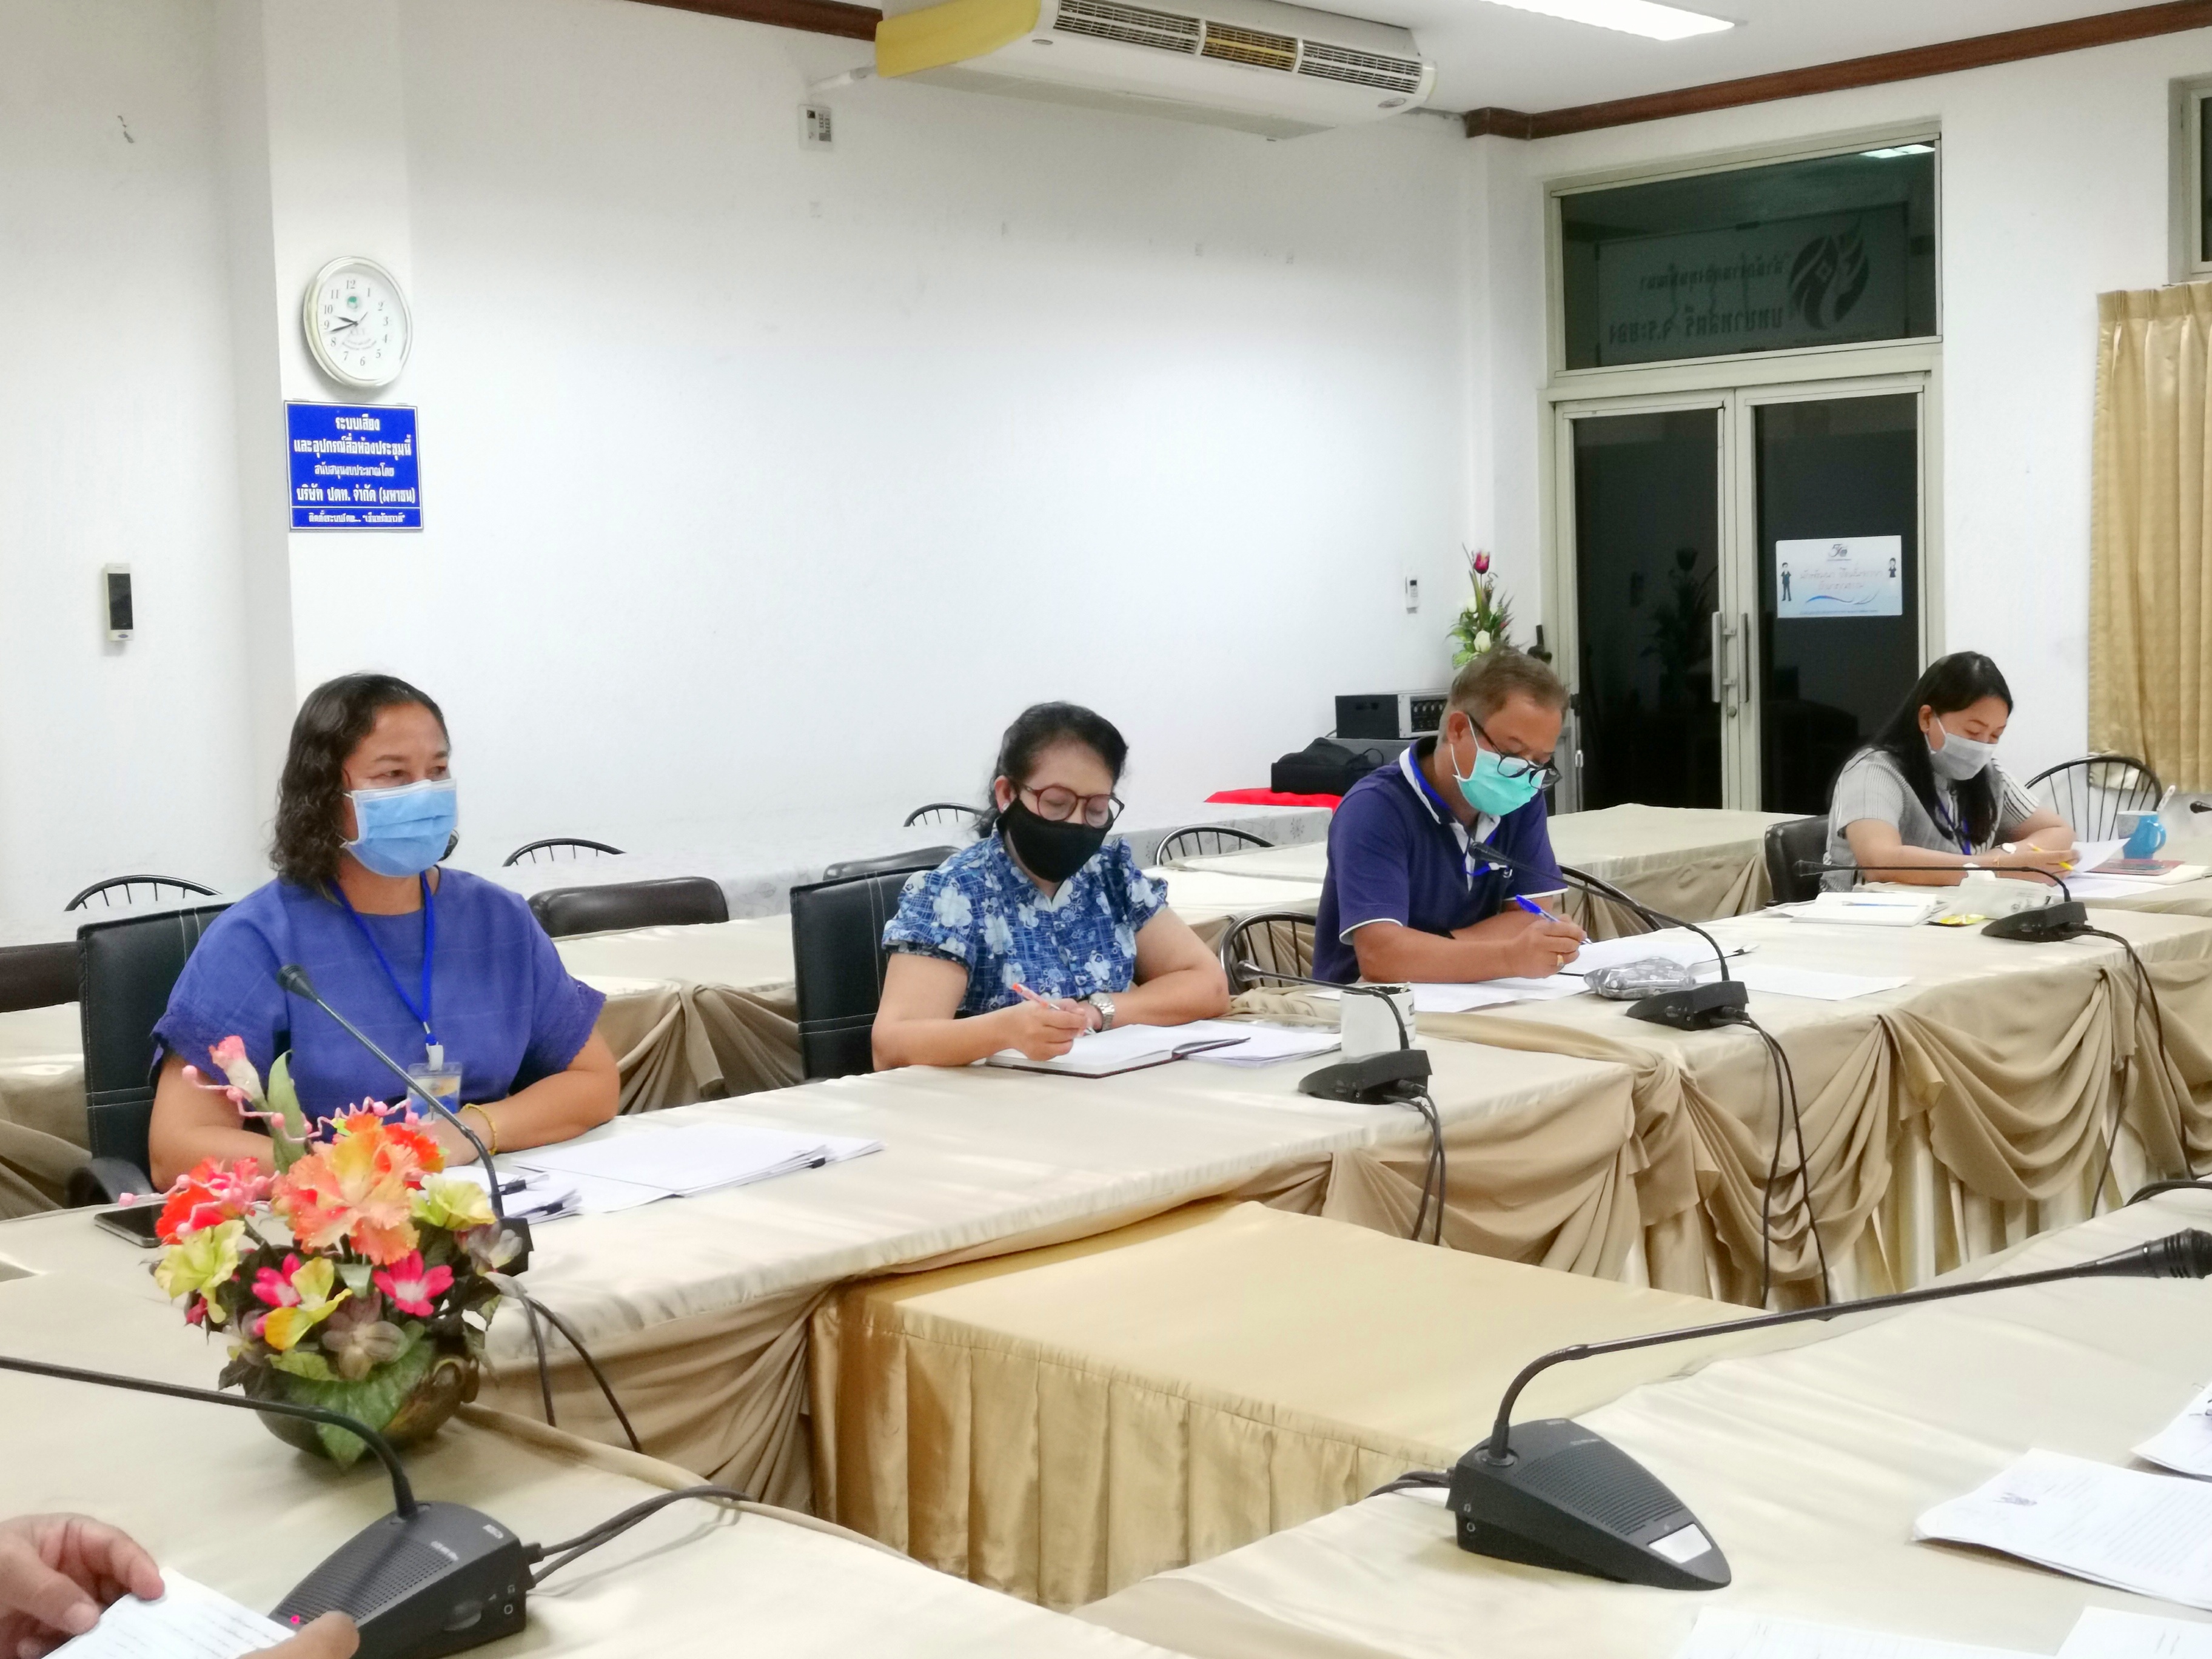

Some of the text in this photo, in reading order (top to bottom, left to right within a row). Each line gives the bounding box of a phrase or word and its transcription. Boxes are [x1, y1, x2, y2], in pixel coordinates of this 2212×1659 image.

[346, 280, 356, 289] 12
[330, 289, 339, 299] 11
[324, 304, 333, 314] 10
[378, 301, 384, 311] 2
[324, 320, 329, 330] 9
[383, 317, 389, 326] 3
[343, 351, 349, 361] 7
[375, 349, 381, 358] 5
[360, 357, 365, 366] 6
[335, 414, 380, 431] ระบบเสียง
[293, 433, 412, 461] และอุปกรณ์สื่อห้องประชุมนี้
[297, 483, 415, 504] บริษัท ปตท. จำกัด (มหาชน)
